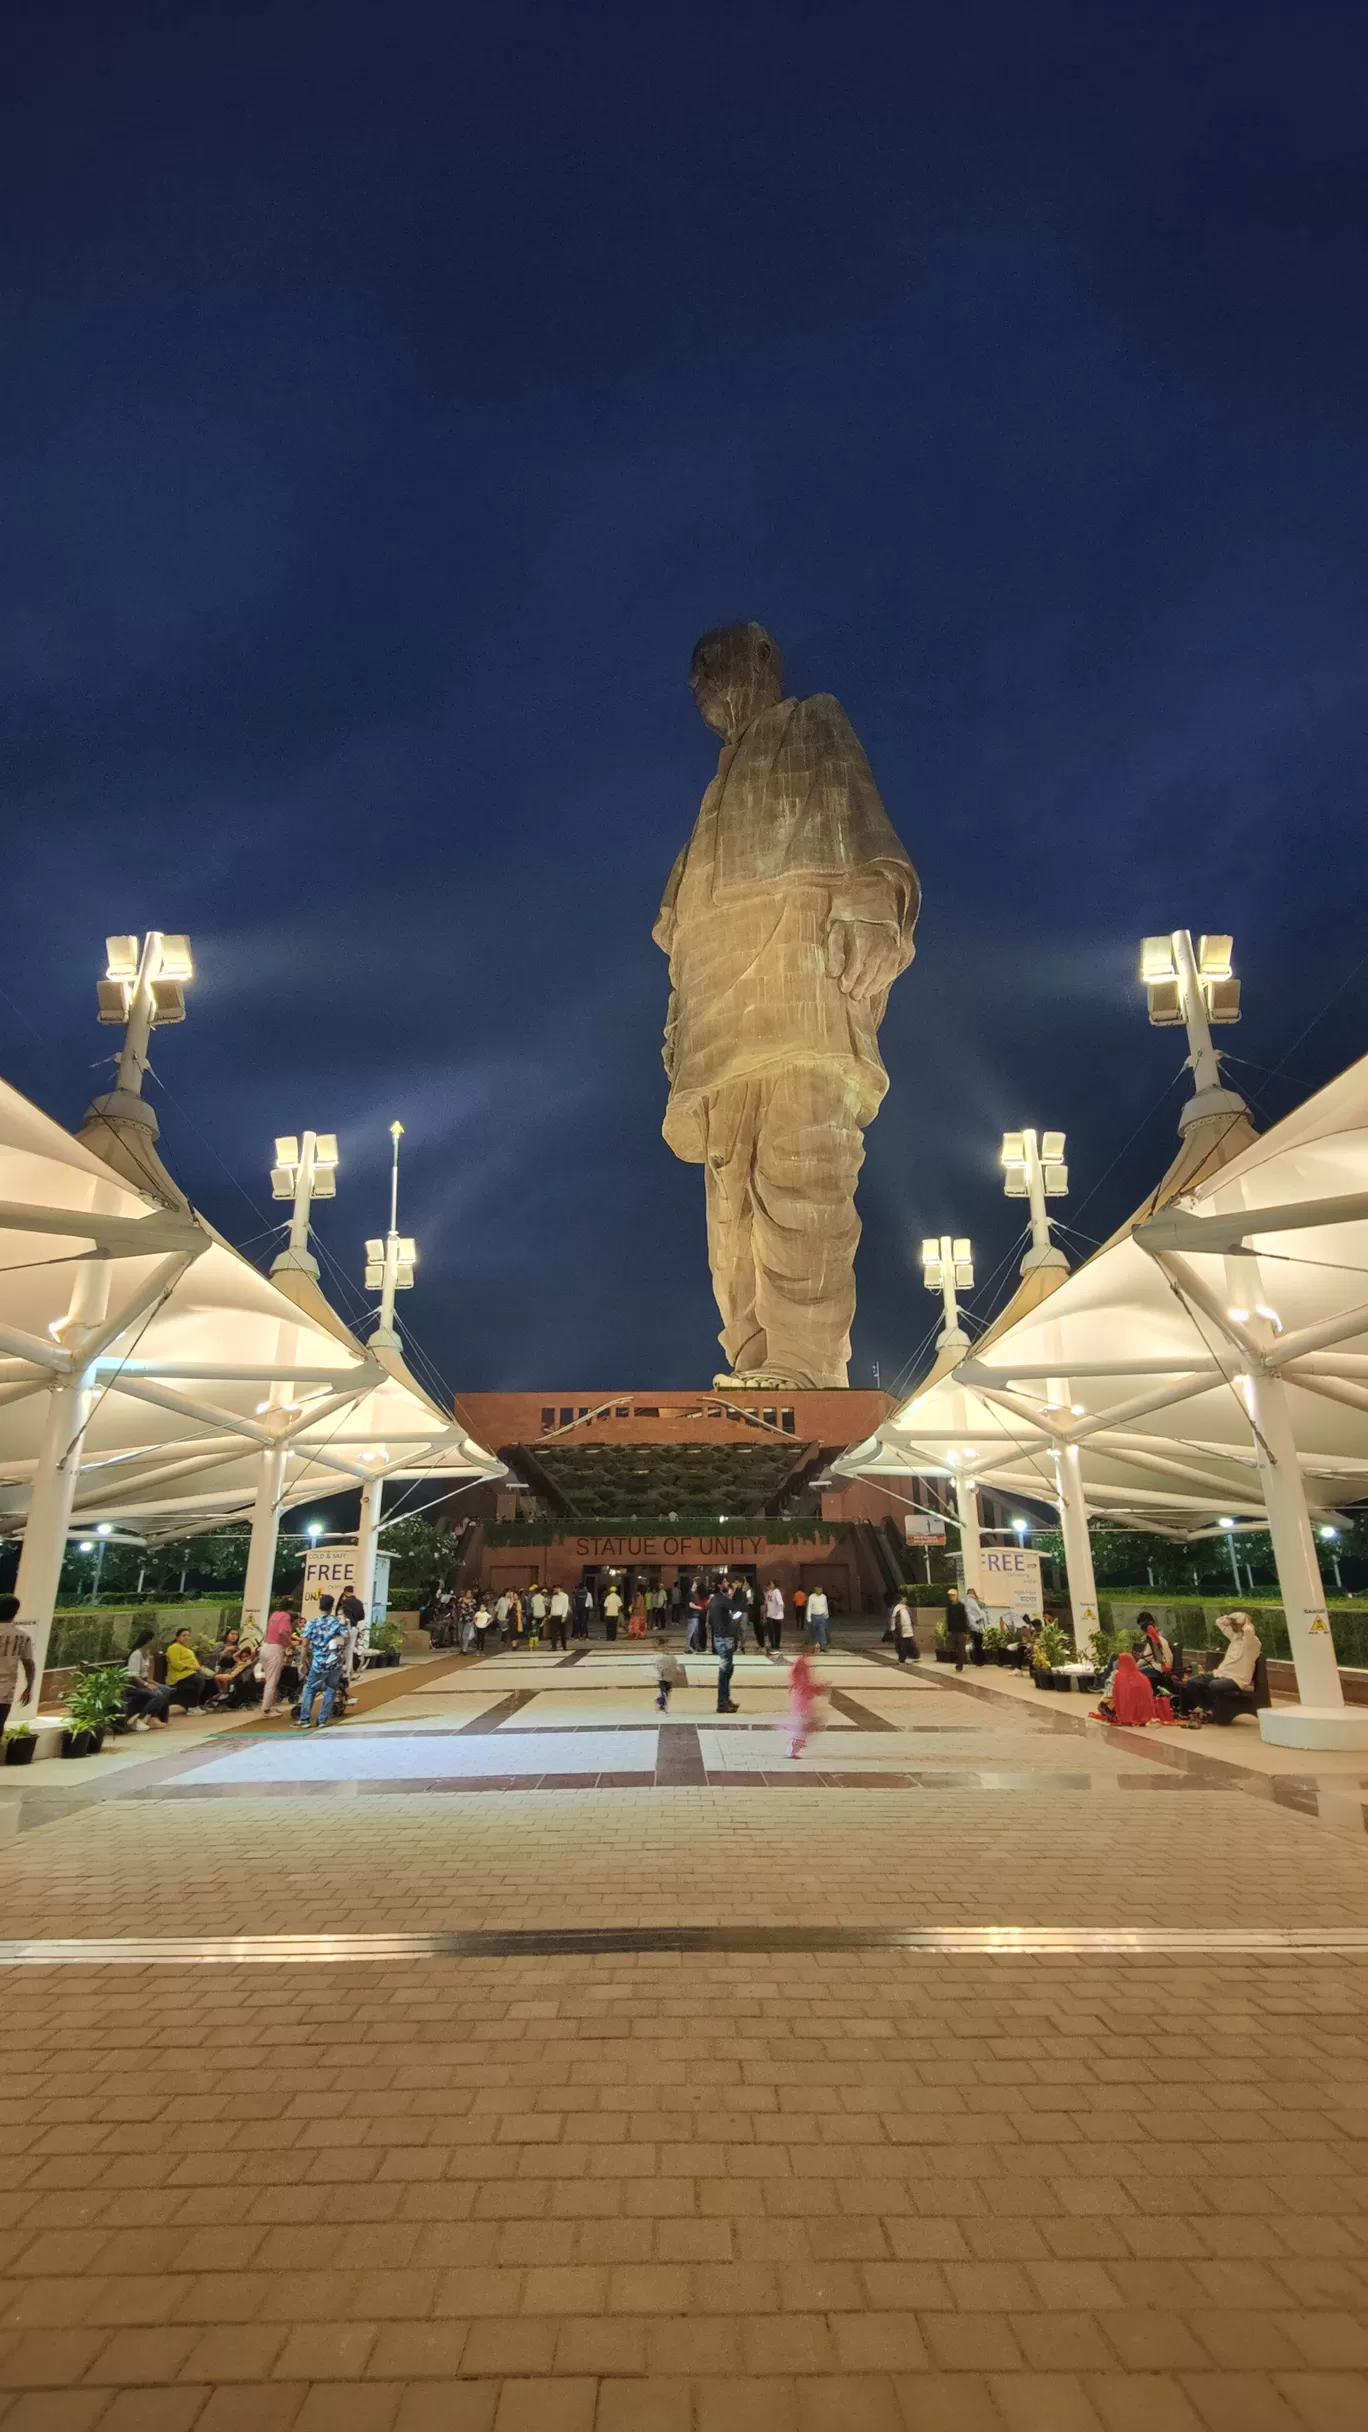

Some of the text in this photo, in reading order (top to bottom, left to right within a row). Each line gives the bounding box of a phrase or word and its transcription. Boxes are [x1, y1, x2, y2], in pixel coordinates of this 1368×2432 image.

[577, 1536, 763, 1556] STATUE OF UNITY
[307, 1564, 354, 1581] FREE
